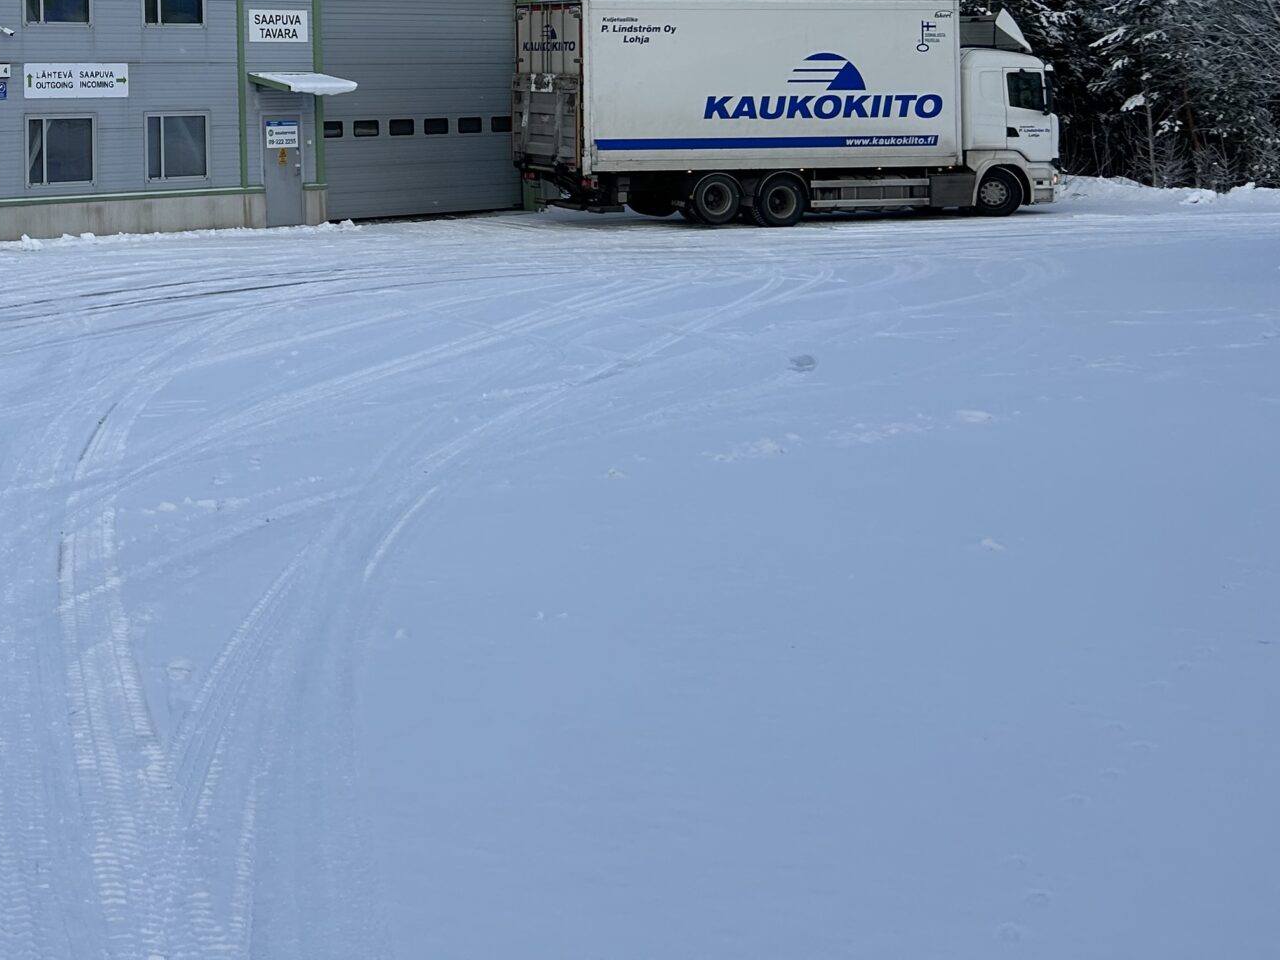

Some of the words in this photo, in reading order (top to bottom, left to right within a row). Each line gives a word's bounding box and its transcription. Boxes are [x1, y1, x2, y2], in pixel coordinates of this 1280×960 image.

[254, 14, 301, 25] SAAPUVA
[259, 28, 298, 39] TAVARA
[601, 25, 609, 33] P.
[612, 25, 661, 33] Lindström
[663, 25, 677, 34] Oy
[623, 35, 650, 44] Lohja
[36, 70, 73, 79] LÄHTEVÄ
[35, 81, 74, 89] OUTGOING
[703, 94, 943, 120] KAUKOKIITO
[845, 136, 935, 146] www.kaukokiito.fi
